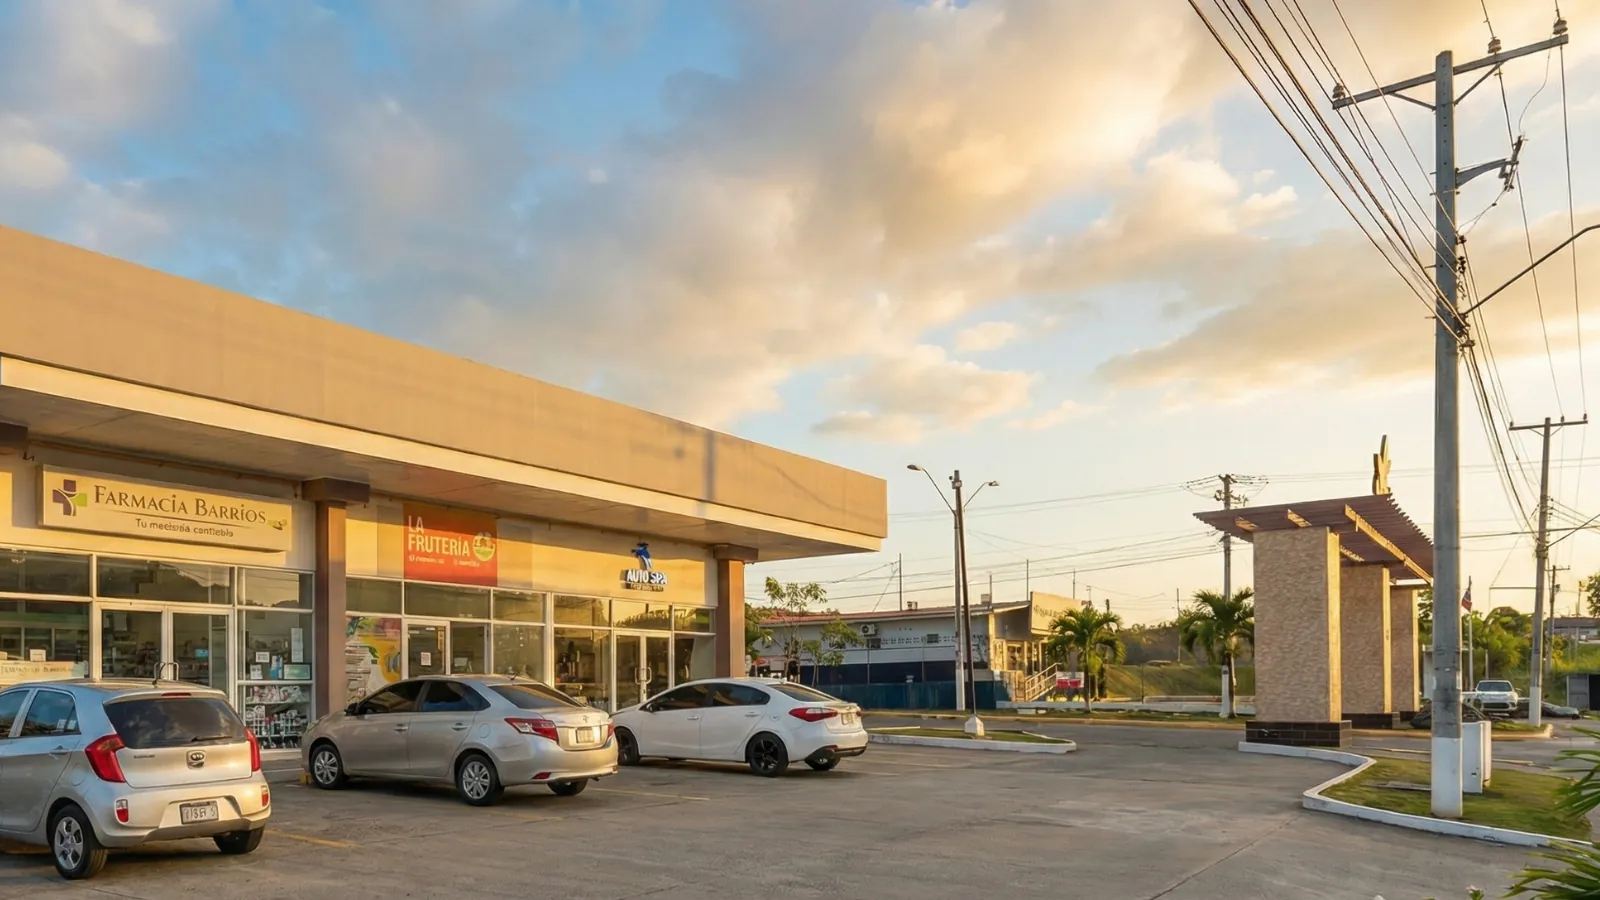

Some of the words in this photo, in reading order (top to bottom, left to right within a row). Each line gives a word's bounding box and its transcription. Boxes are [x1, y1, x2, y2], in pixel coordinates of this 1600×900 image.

[135, 518, 148, 529] Tu
[408, 515, 424, 534] LA
[408, 533, 470, 557] FRUTERÍA
[626, 569, 649, 583] AUTO
[650, 571, 668, 585] SPA
